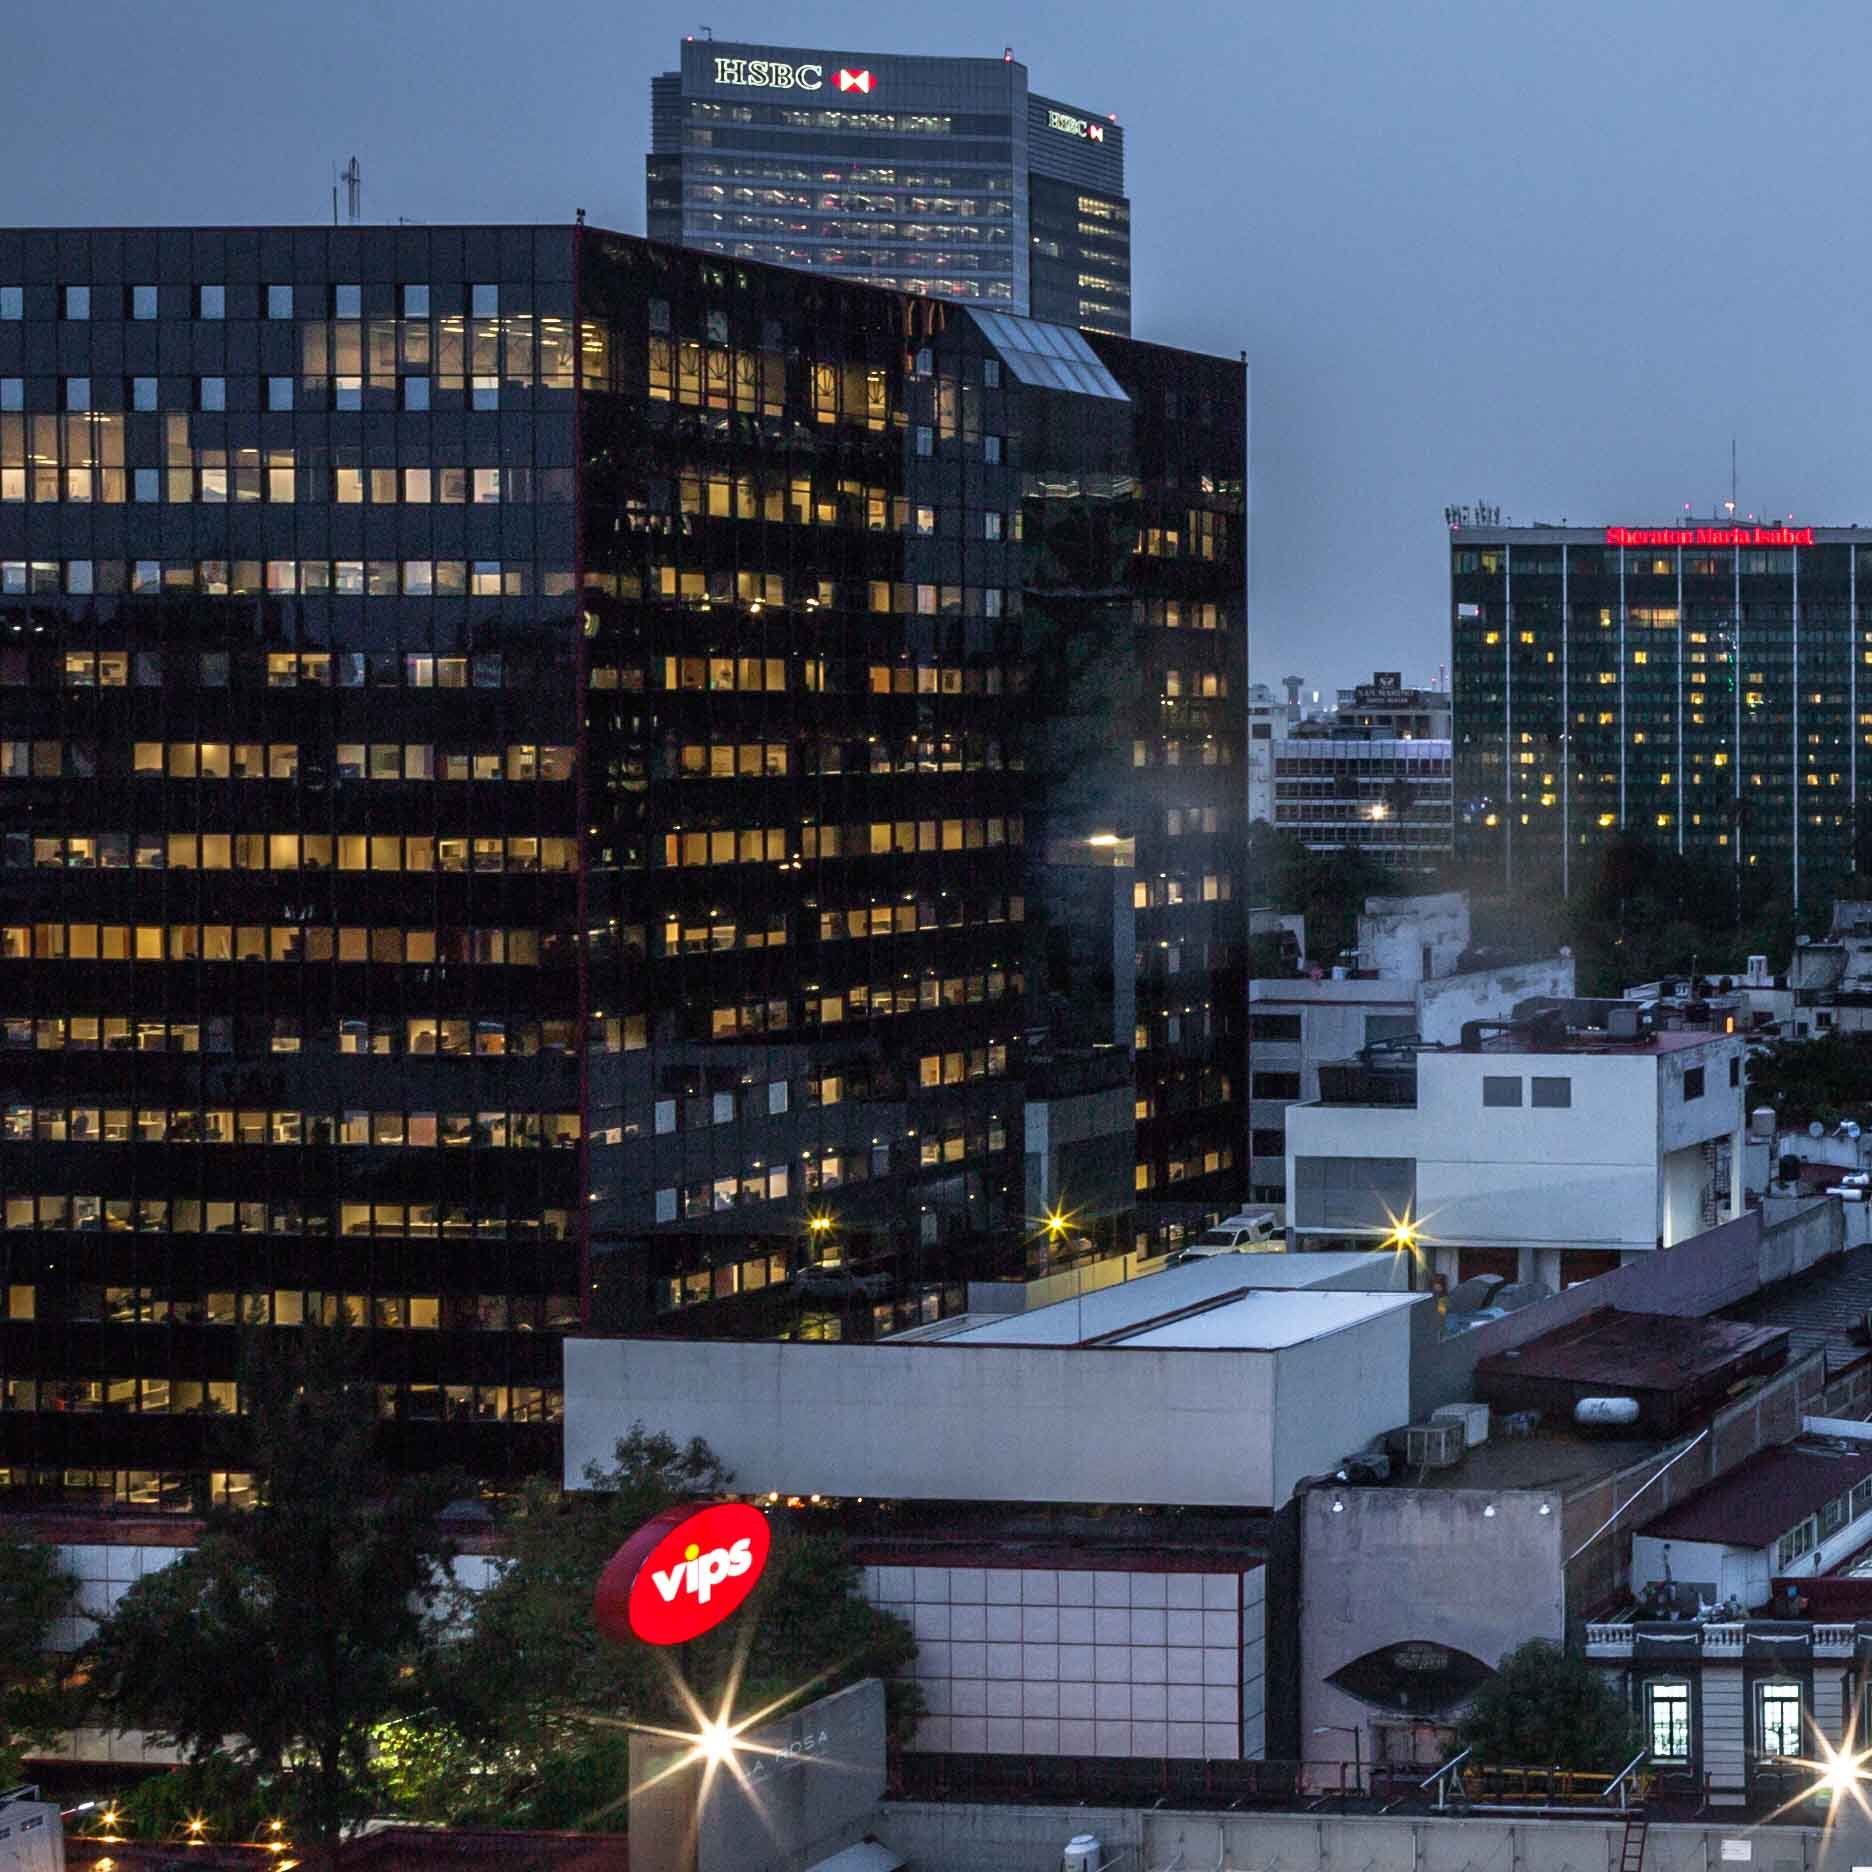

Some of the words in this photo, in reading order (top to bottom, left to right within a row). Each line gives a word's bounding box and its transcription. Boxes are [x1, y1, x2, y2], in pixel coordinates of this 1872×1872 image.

[714, 58, 823, 90] HSBC
[1608, 527, 1694, 546] Sheraton
[652, 1537, 753, 1605] vips
